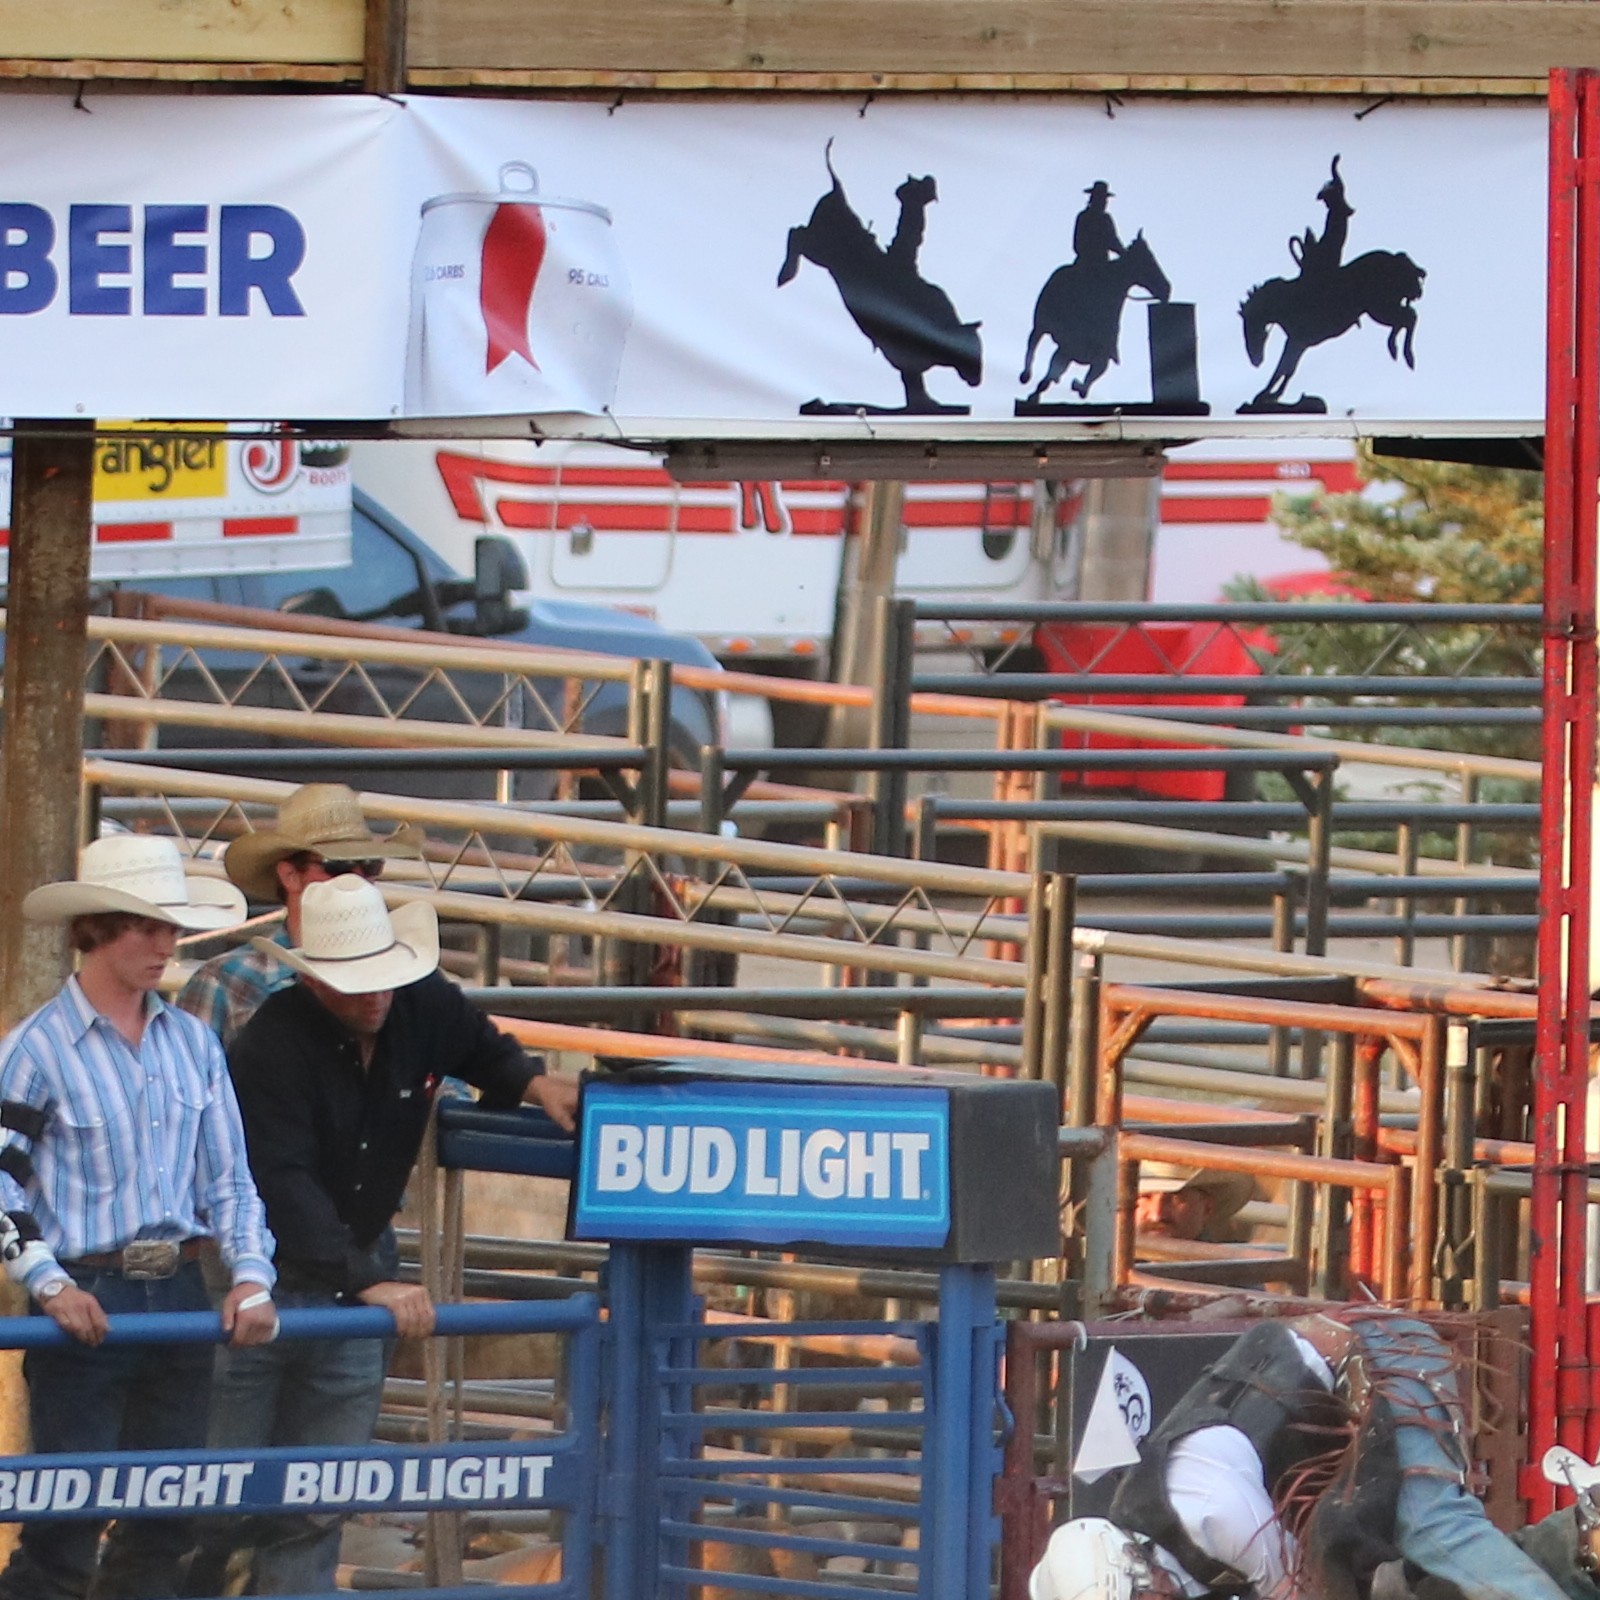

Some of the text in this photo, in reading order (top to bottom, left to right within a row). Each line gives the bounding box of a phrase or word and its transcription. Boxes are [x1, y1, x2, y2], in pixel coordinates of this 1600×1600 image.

[0, 203, 307, 317] BEER
[567, 267, 585, 285] 95
[597, 1123, 931, 1201] BUD LIGHT
[97, 1461, 255, 1508] LIGHT
[283, 1454, 554, 1507] BUD LIGHT
